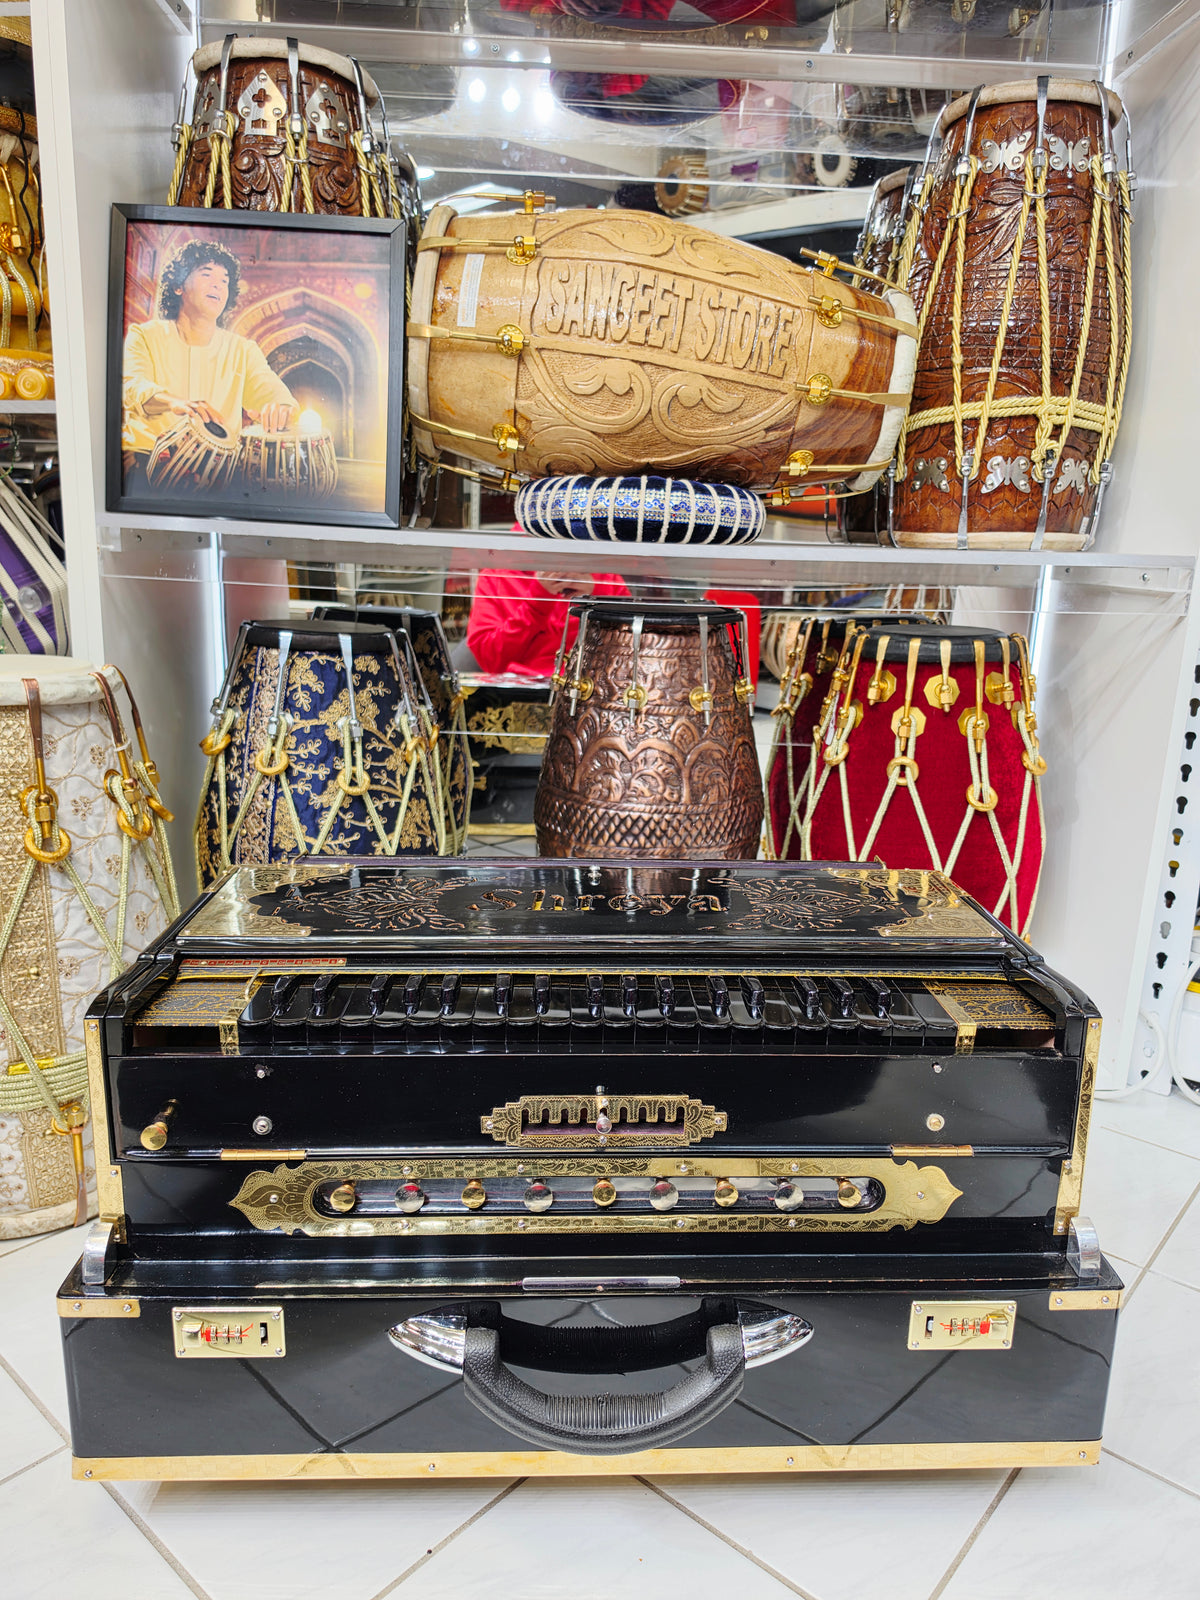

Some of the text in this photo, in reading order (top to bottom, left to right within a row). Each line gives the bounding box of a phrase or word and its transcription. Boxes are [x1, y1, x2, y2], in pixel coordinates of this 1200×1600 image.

[545, 261, 695, 353] SANGEET
[695, 282, 795, 379] STORE
[467, 888, 728, 916] Shreya
